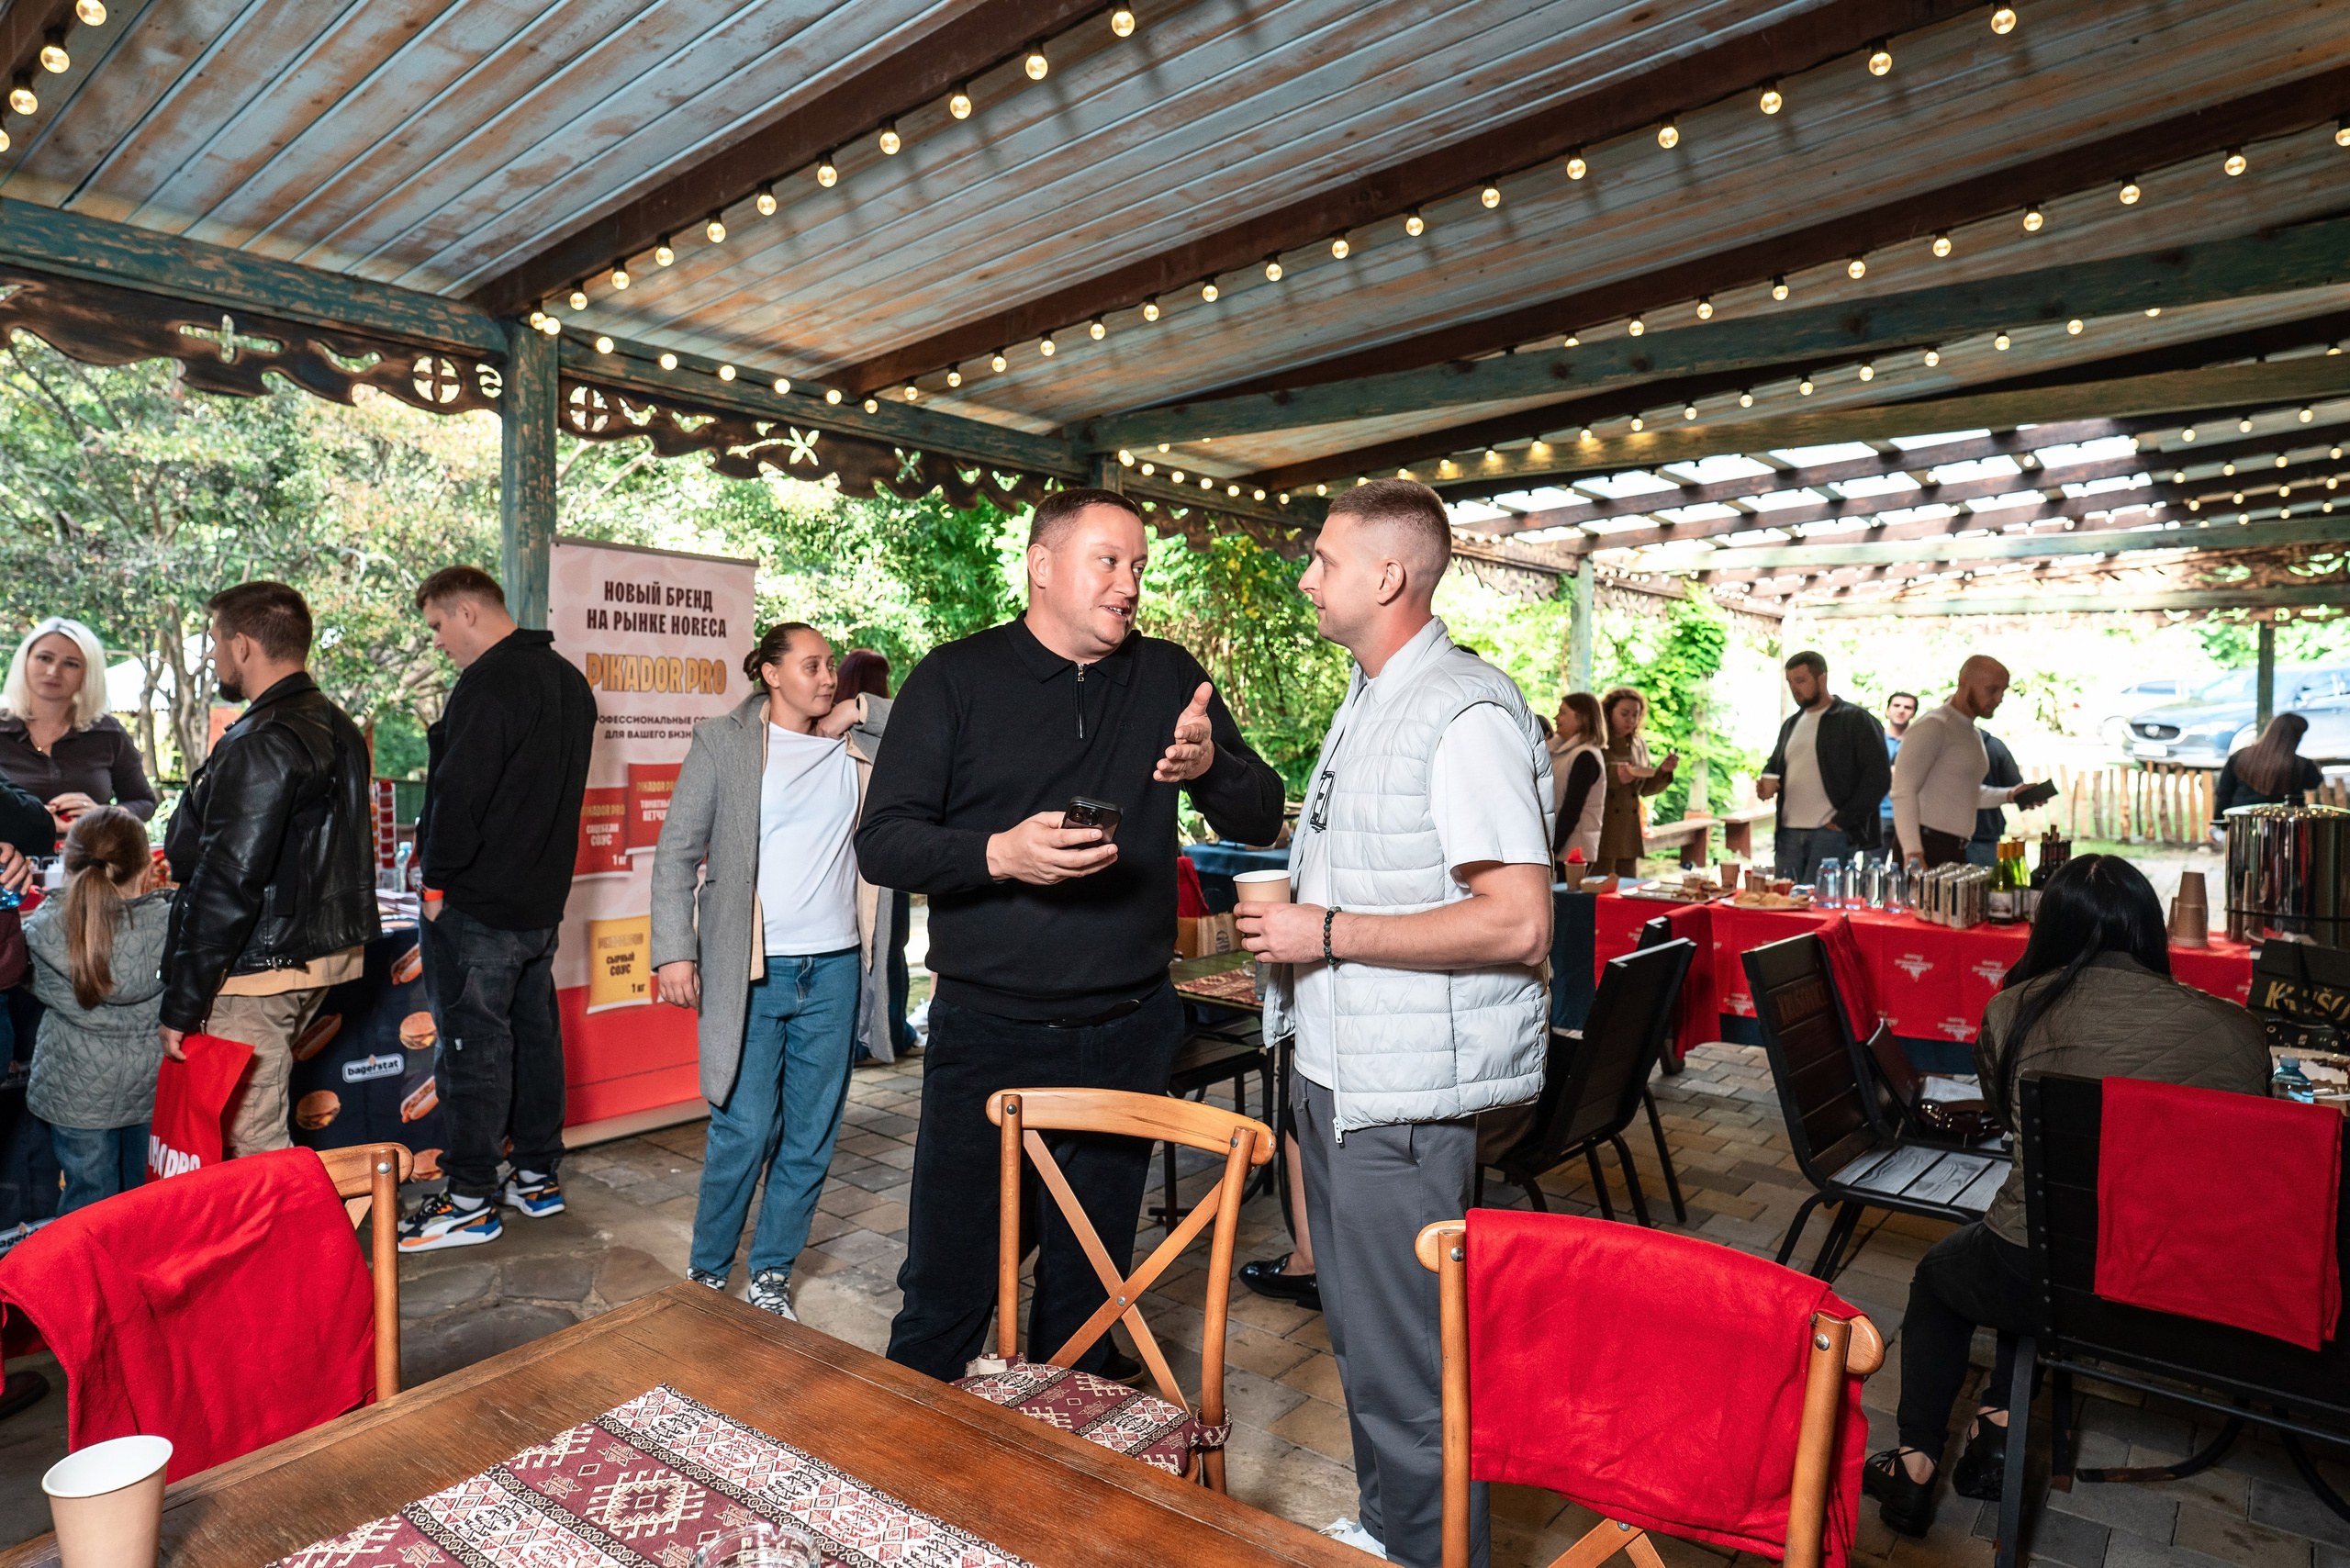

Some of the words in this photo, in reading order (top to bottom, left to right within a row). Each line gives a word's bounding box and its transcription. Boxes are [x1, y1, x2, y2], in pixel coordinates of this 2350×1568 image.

[604, 580, 661, 606] НОВЫЙ
[666, 586, 713, 613] БРЕНД
[587, 609, 609, 631] НА
[613, 610, 666, 634] РЫНКЕ
[671, 615, 727, 638] HORECA
[586, 653, 683, 693] PIKADOR
[685, 657, 727, 695] PRO
[598, 715, 691, 725] ОФЕССИОНАЛЬНЫЕ
[604, 730, 624, 740] ДЛЯ
[627, 730, 666, 740] ВАШЕГО
[668, 730, 692, 739] БИЗН
